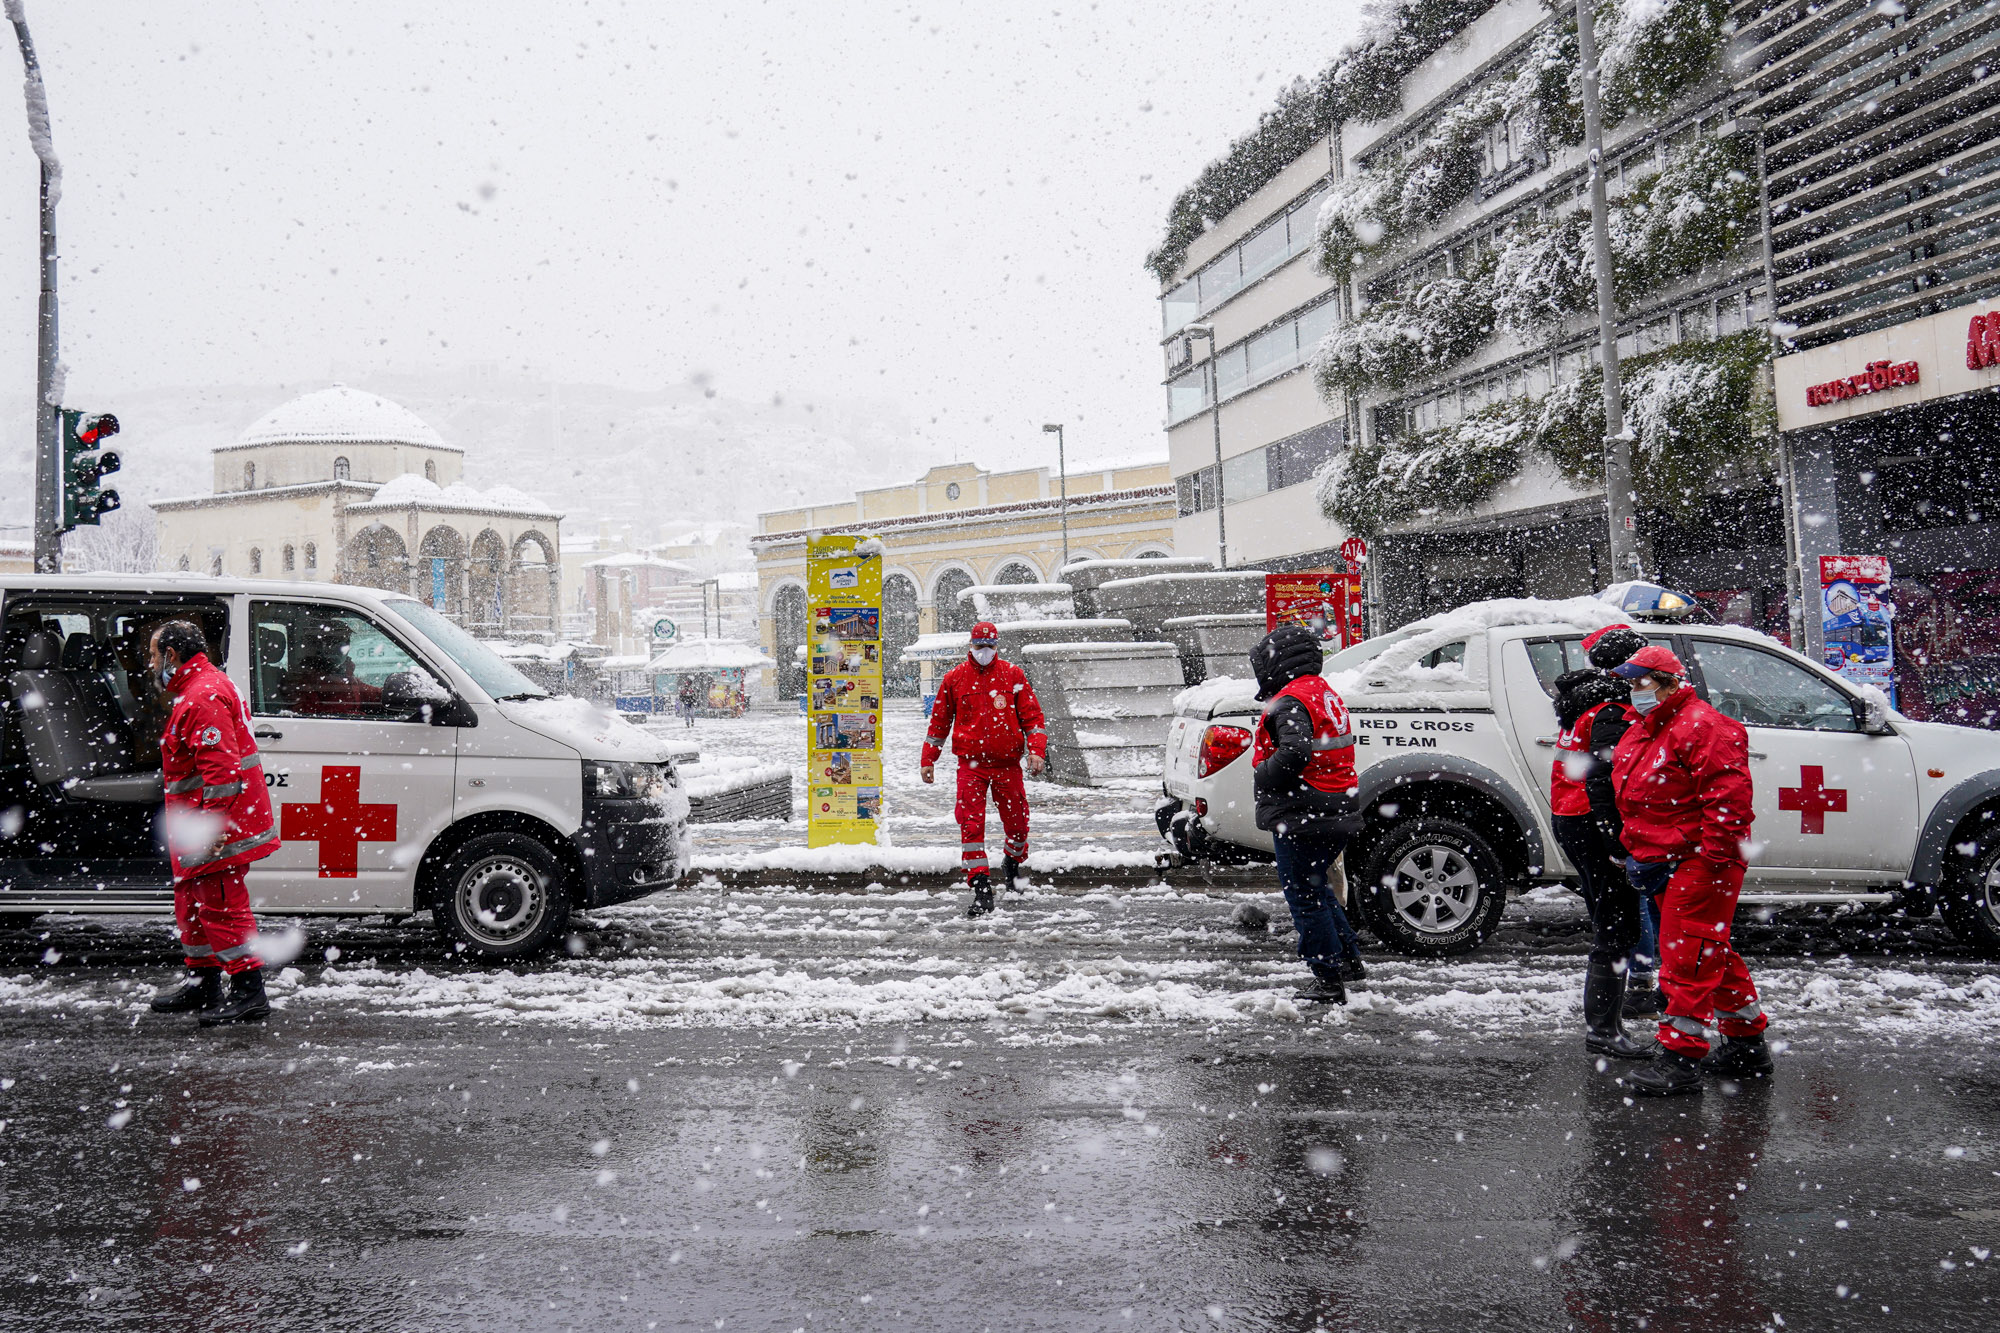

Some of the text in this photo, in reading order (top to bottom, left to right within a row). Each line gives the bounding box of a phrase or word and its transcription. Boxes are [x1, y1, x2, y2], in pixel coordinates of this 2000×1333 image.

[1806, 359, 1919, 407] παιχνίδια
[1343, 542, 1364, 557] A14
[1359, 718, 1398, 730] RED
[1410, 720, 1475, 732] CROSS
[1382, 736, 1437, 748] TEAM
[1388, 833, 1463, 864] YOKOHAMA
[1414, 895, 1492, 945] GEOLANDAR
